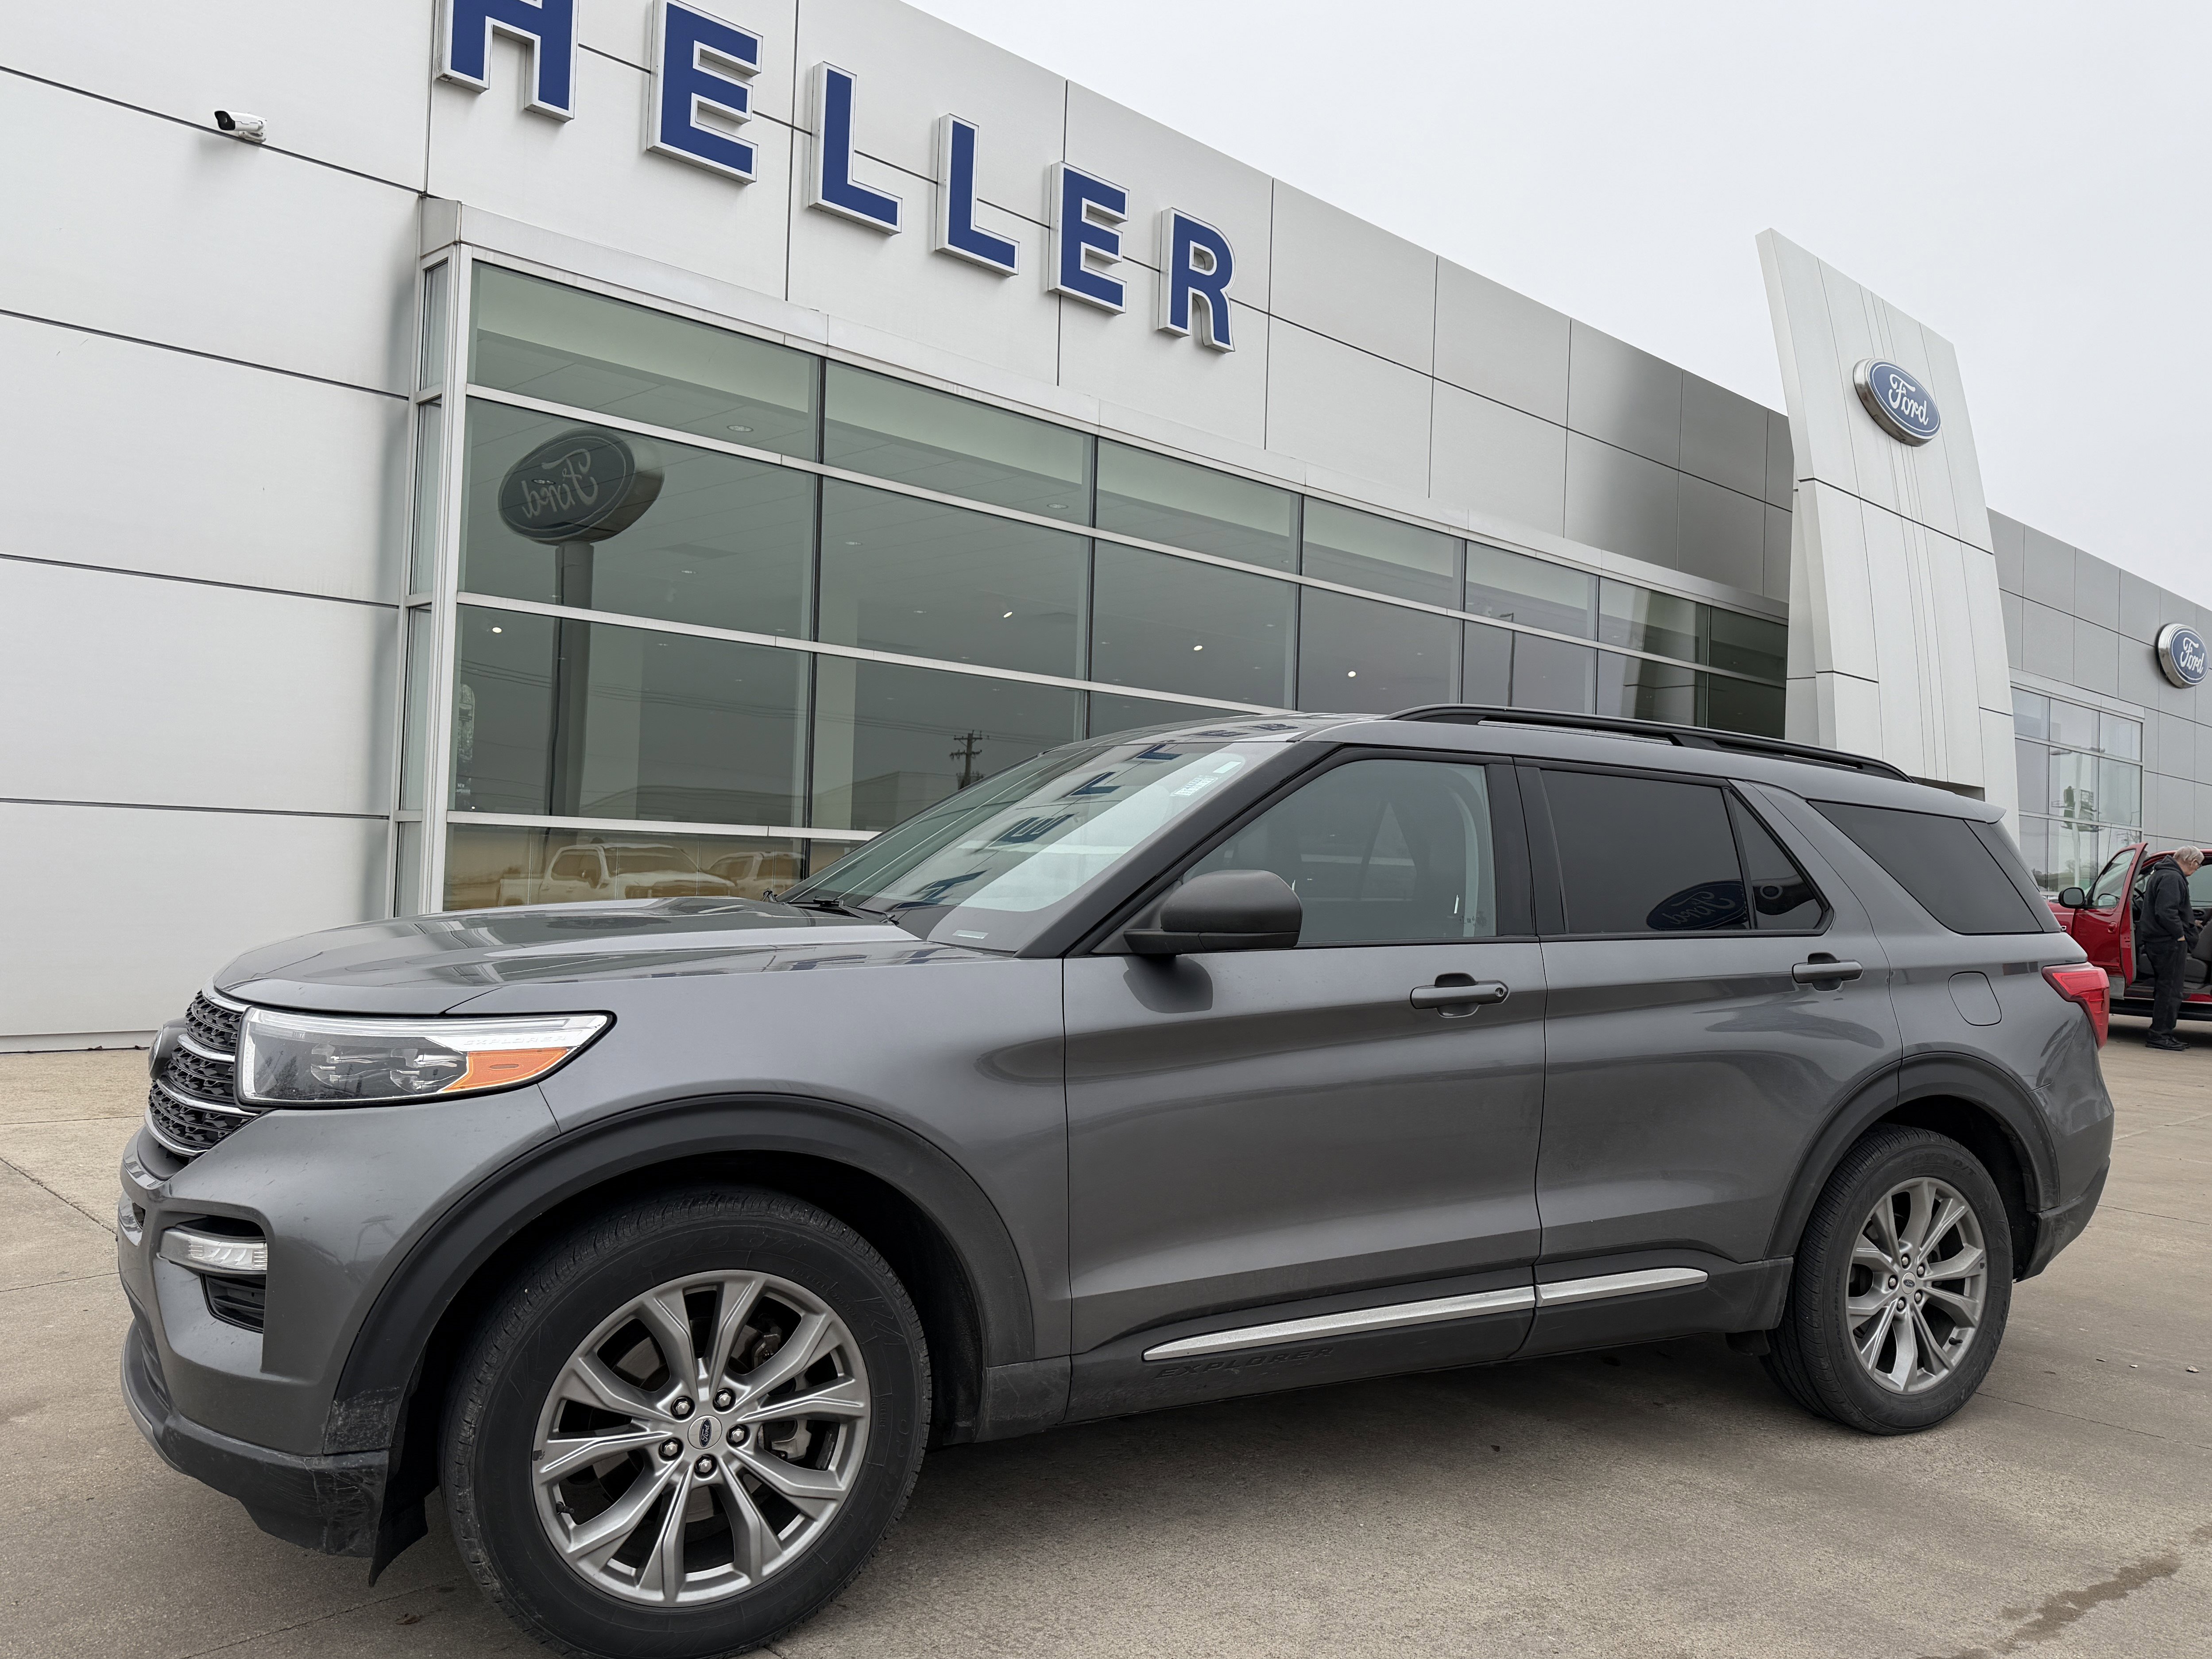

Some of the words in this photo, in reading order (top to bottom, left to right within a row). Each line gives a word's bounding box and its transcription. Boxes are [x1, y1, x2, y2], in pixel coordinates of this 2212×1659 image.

[436, 0, 1235, 354] HELLER
[1888, 374, 1929, 425] Ford
[2180, 637, 2204, 674] Ford
[464, 1036, 567, 1045] EXPLORER
[1154, 1347, 1334, 1379] EXPLORER
[701, 1424, 710, 1442] Ford
